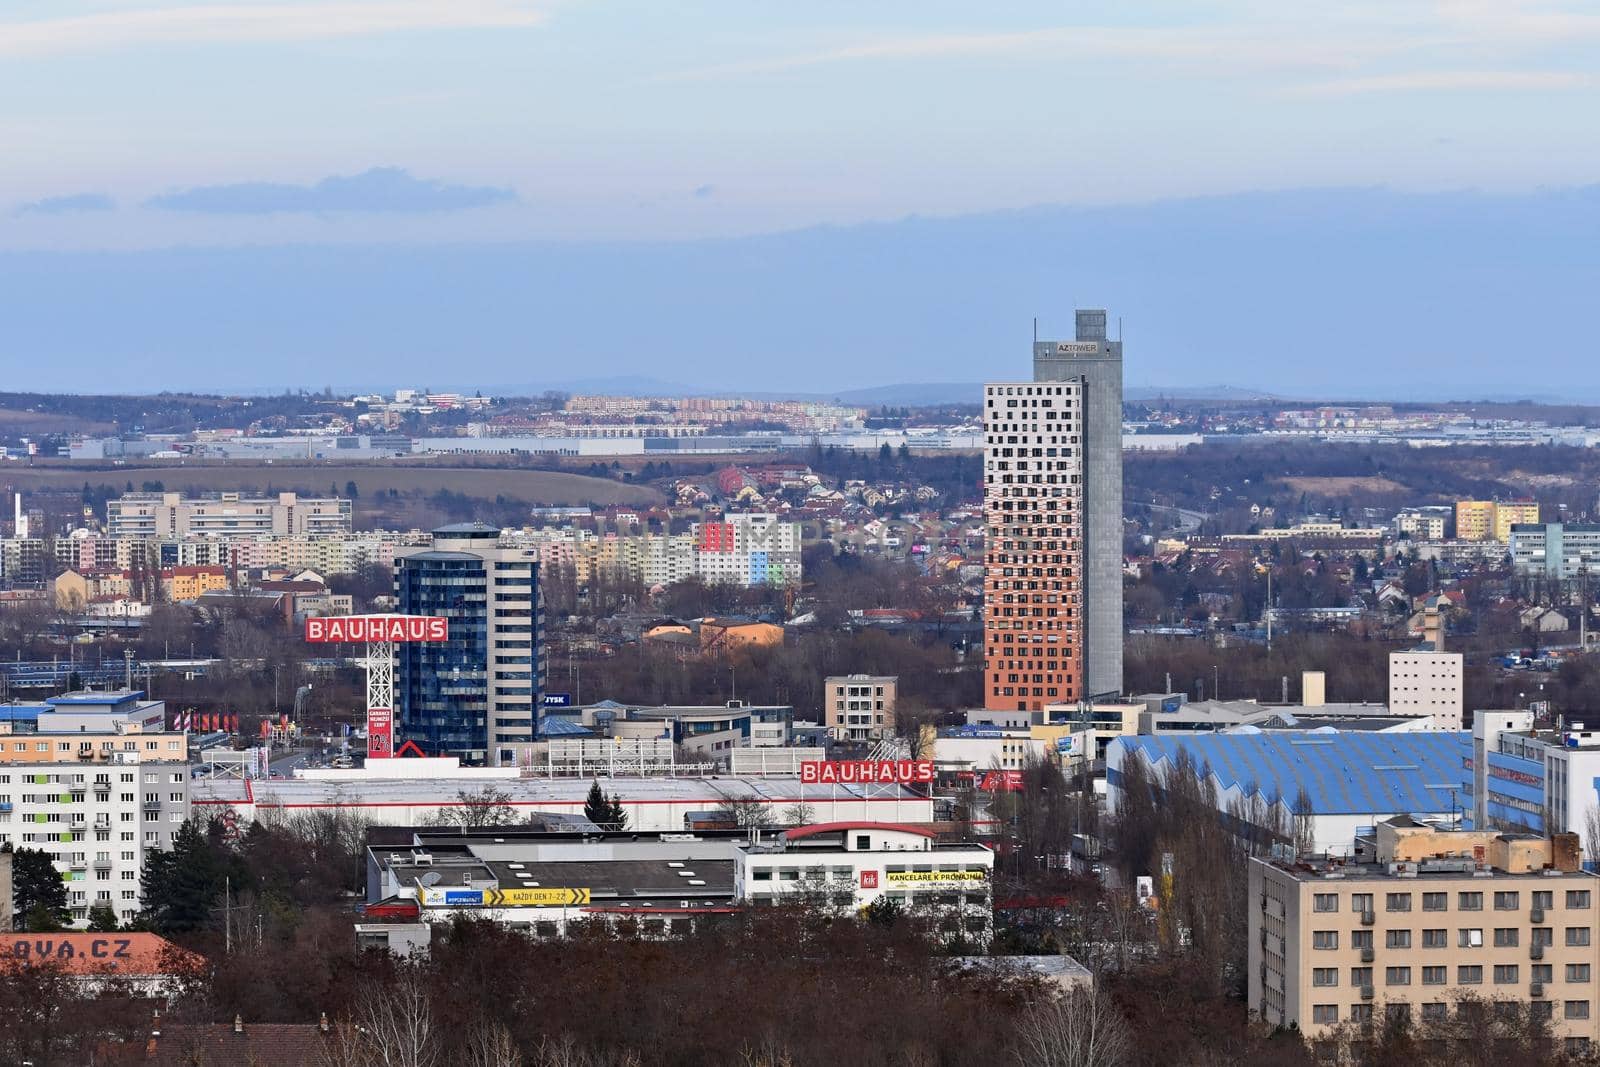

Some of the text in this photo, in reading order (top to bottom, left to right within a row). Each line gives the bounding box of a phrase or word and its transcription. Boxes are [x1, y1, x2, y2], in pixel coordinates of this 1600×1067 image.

[308, 621, 445, 639] BAUHAUS
[370, 734, 391, 752] 12%
[803, 763, 931, 781] BAUHAUS
[863, 874, 876, 886] kik
